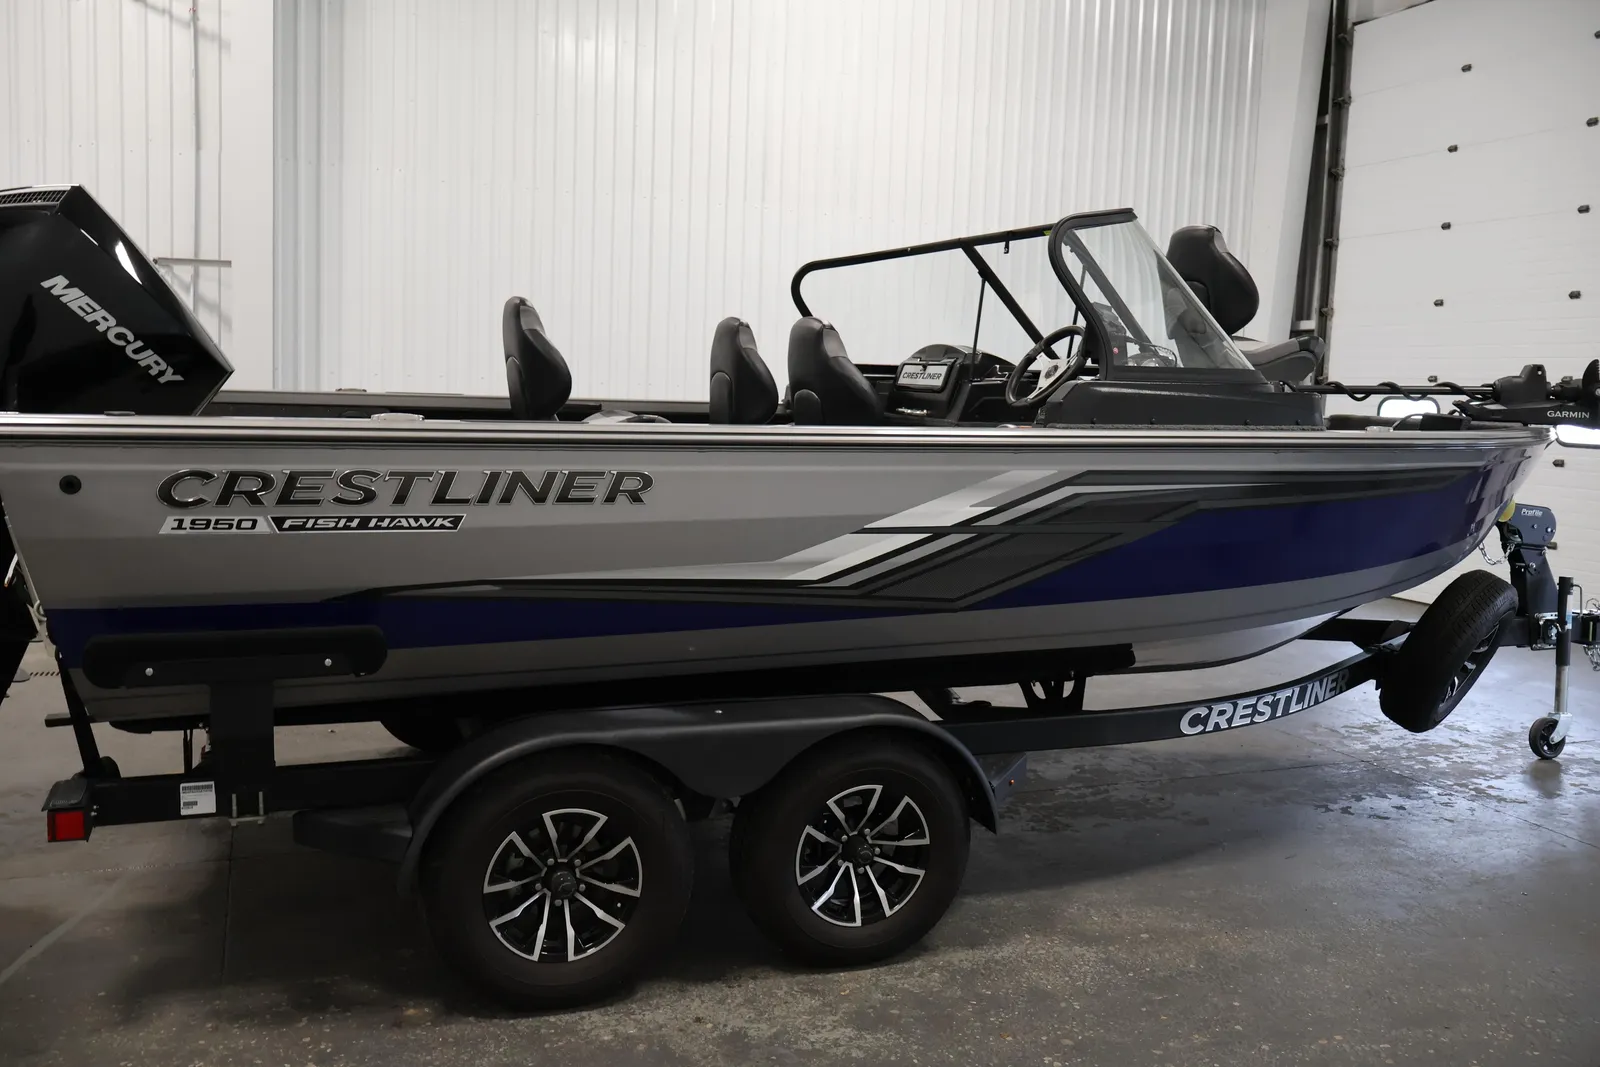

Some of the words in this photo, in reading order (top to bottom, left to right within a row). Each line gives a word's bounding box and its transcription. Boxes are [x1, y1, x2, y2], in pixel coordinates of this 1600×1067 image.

[40, 275, 184, 384] MERCURY
[902, 371, 943, 380] CRESTLINER
[1546, 410, 1590, 419] GARMIN
[156, 468, 655, 509] CRESTLINER
[1521, 508, 1543, 517] Profile
[170, 517, 258, 531] 1950
[281, 517, 361, 529] FISH
[367, 516, 456, 528] HAWK
[1179, 668, 1350, 735] CRESTLINER
